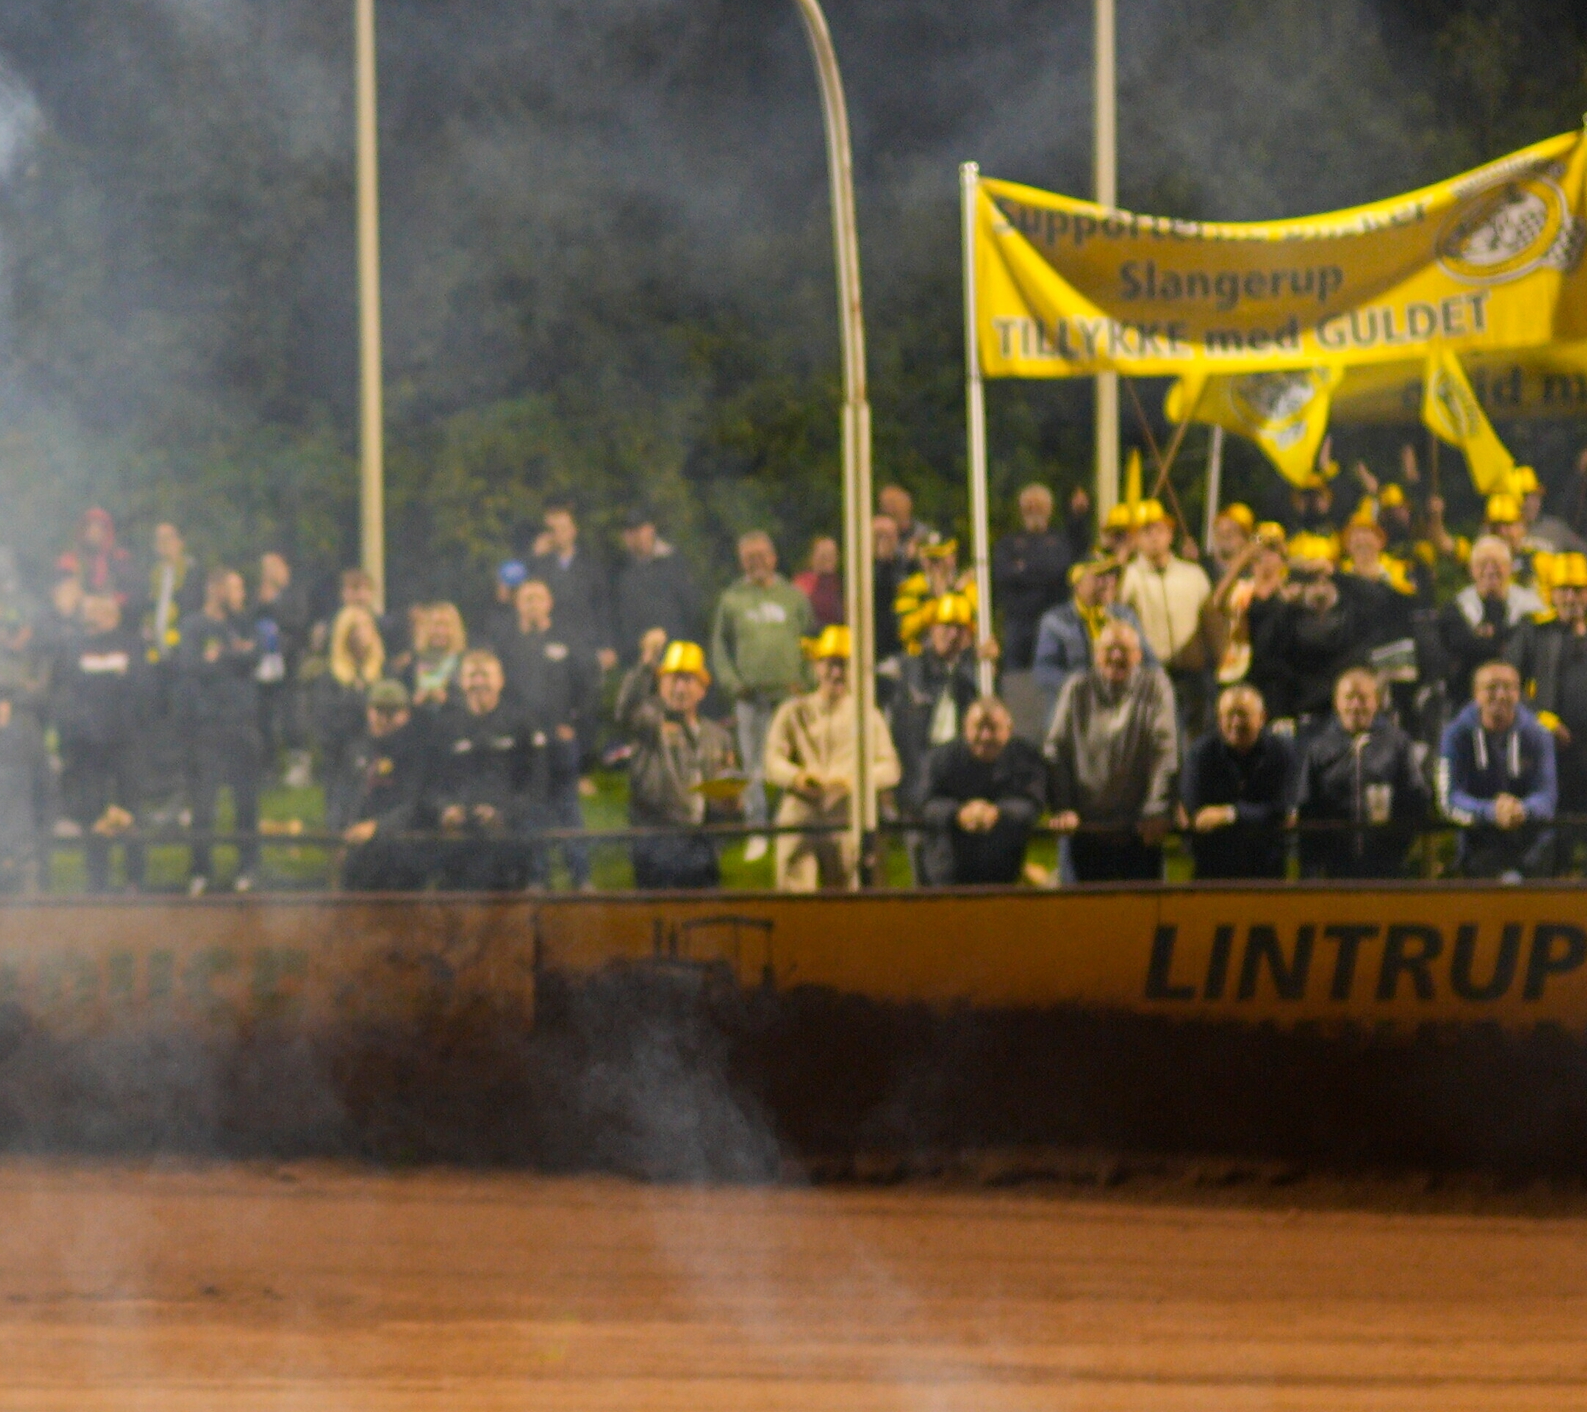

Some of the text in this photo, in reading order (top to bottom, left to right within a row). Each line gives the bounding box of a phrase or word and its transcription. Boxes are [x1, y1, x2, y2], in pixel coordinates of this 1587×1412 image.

[1119, 260, 1345, 310] Slangerup
[991, 292, 1493, 362] TILLYKKE med GULDET
